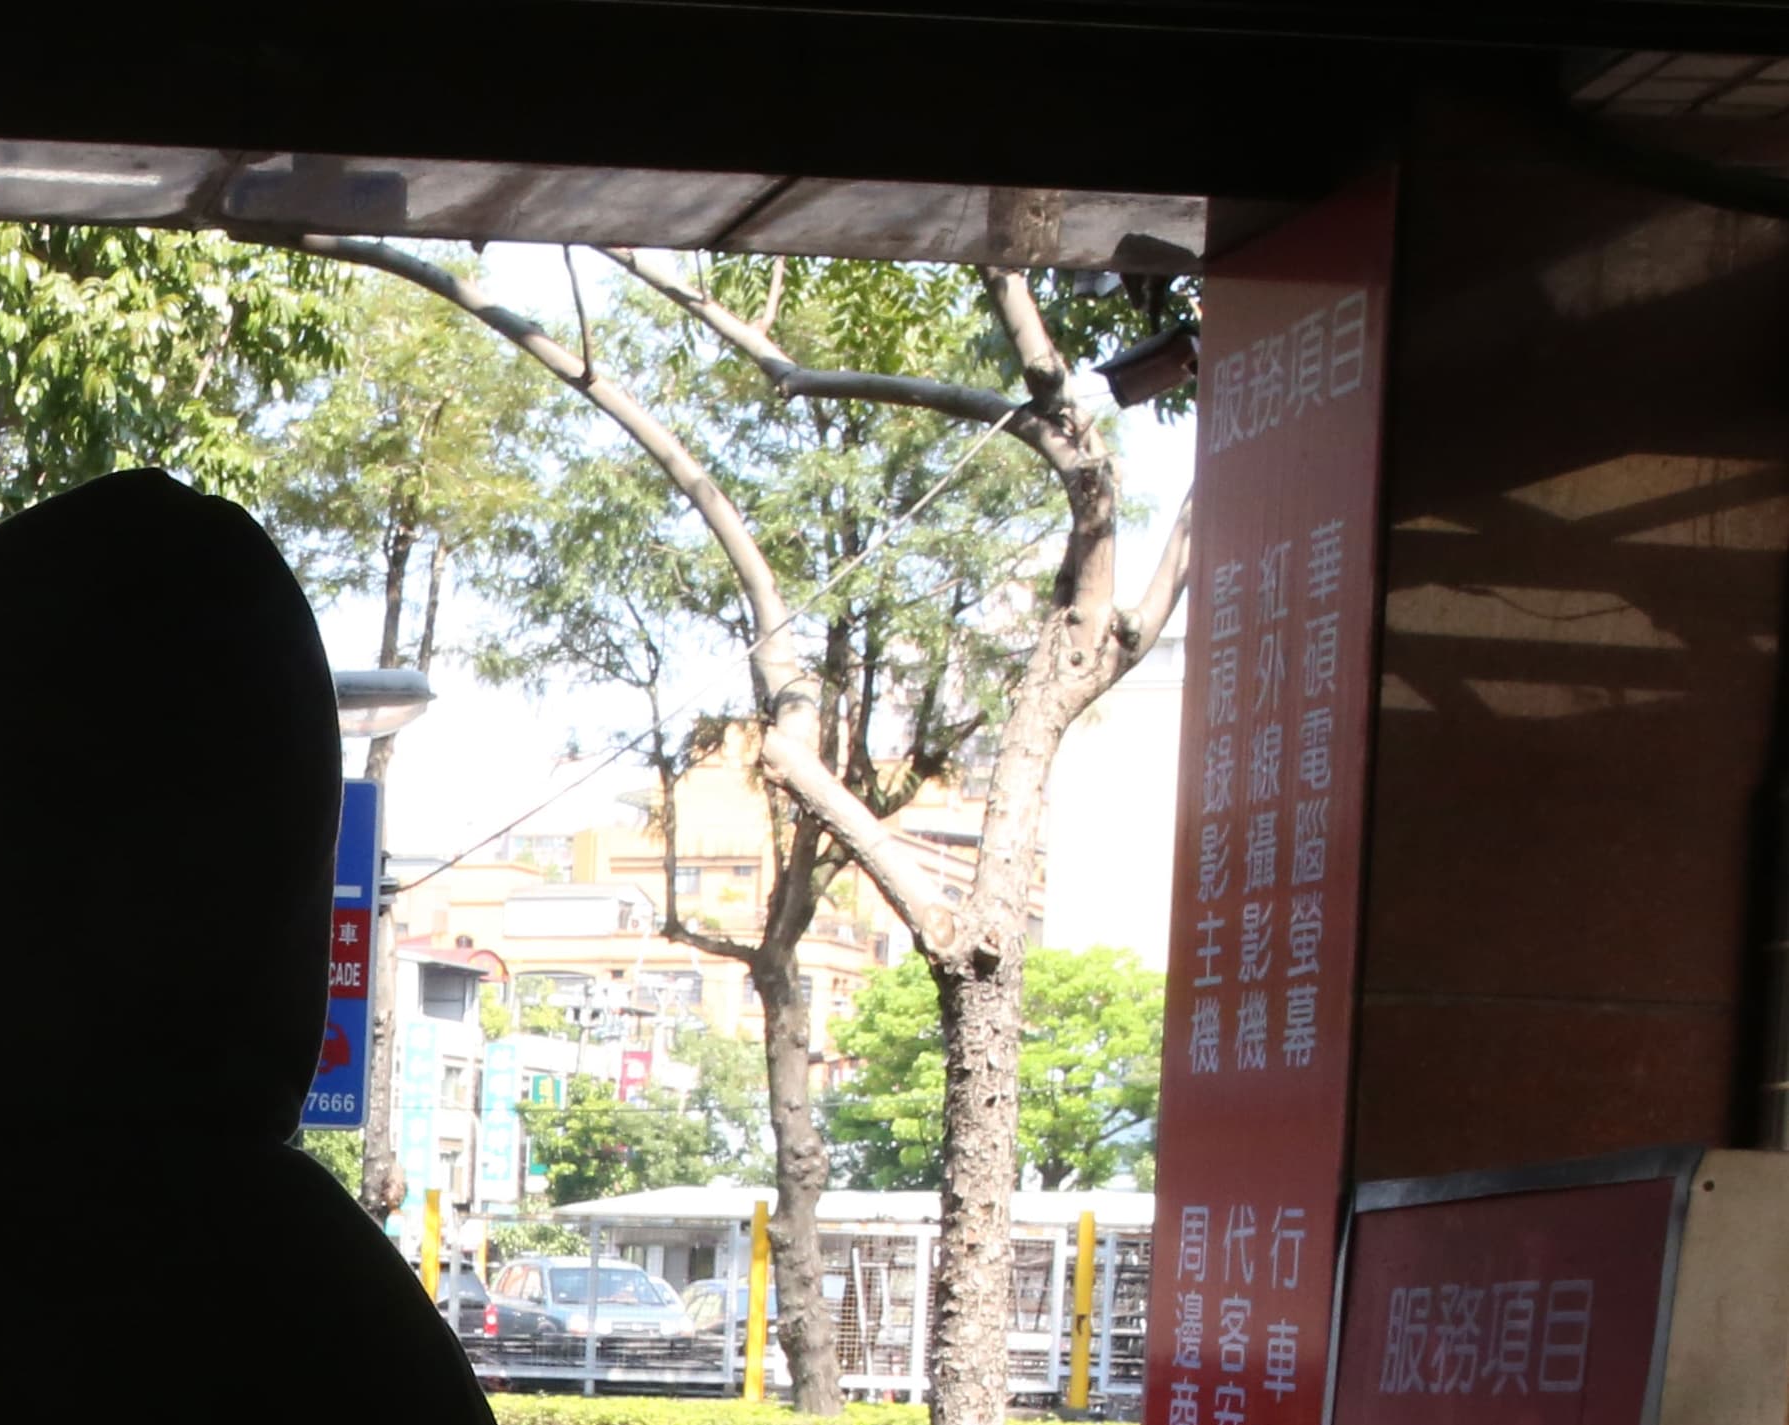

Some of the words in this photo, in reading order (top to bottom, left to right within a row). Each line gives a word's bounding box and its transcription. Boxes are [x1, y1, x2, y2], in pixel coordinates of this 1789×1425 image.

[1212, 292, 1368, 454] 服務項目
[1188, 566, 1243, 1074] 監視錄影主機
[1235, 542, 1292, 1071] 紅外線攝影機
[1282, 518, 1343, 1067] 華碩電腦螢幕
[307, 1092, 355, 1112] 7666
[1381, 1281, 1593, 1396] 服務項目
